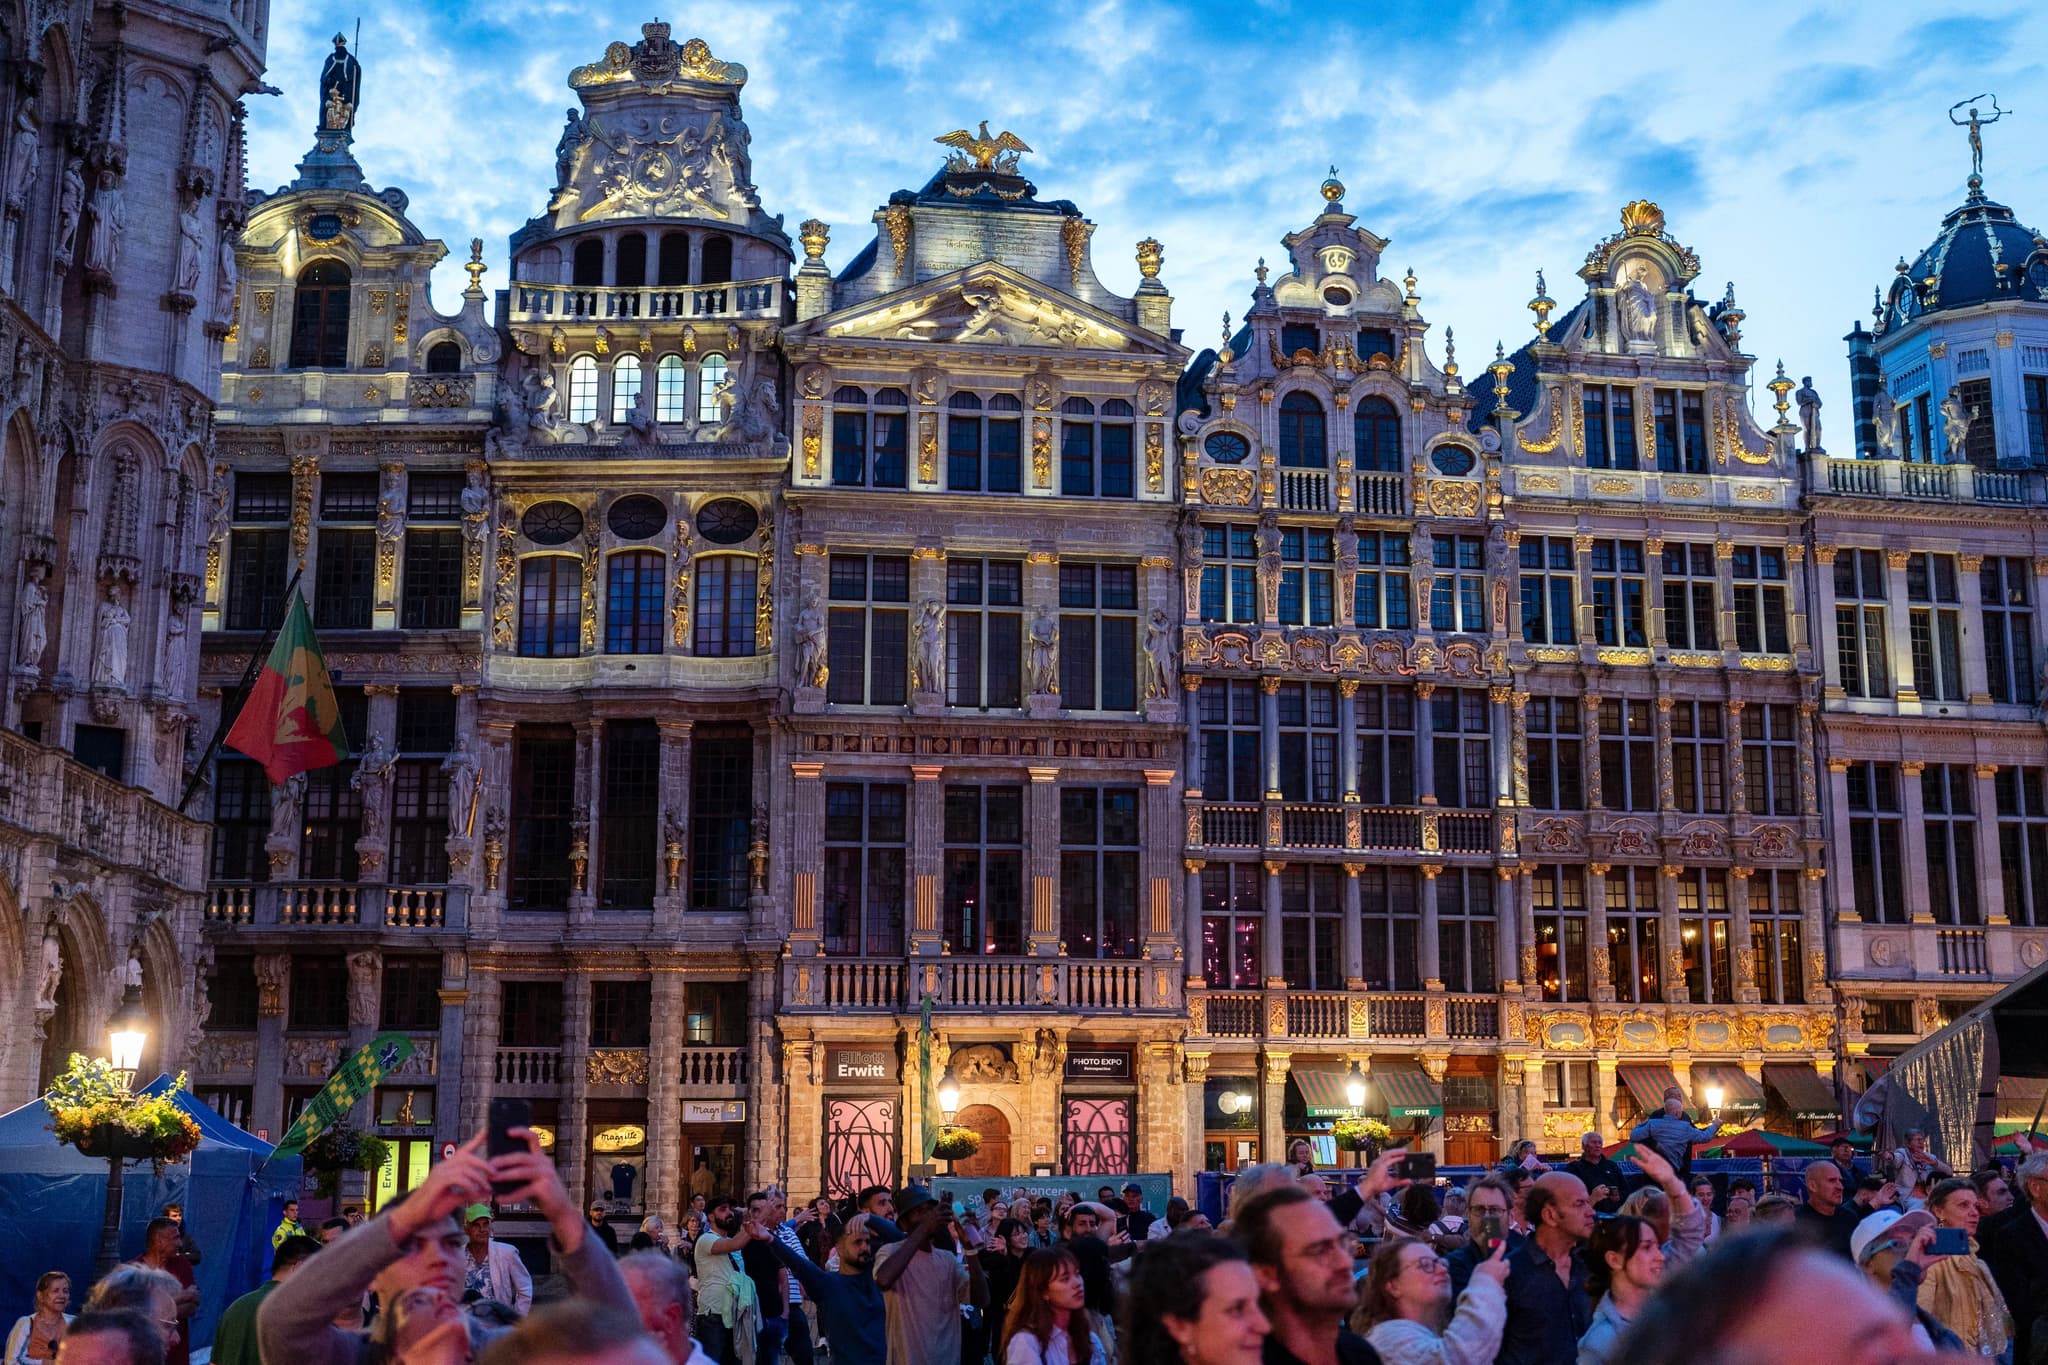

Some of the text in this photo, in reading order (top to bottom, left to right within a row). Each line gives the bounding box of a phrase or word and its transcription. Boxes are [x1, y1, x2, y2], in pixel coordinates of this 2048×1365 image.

[838, 1051, 885, 1065] Elliott
[1072, 1058, 1122, 1066] PHOTO EXPO
[838, 1064, 885, 1077] Erwitt
